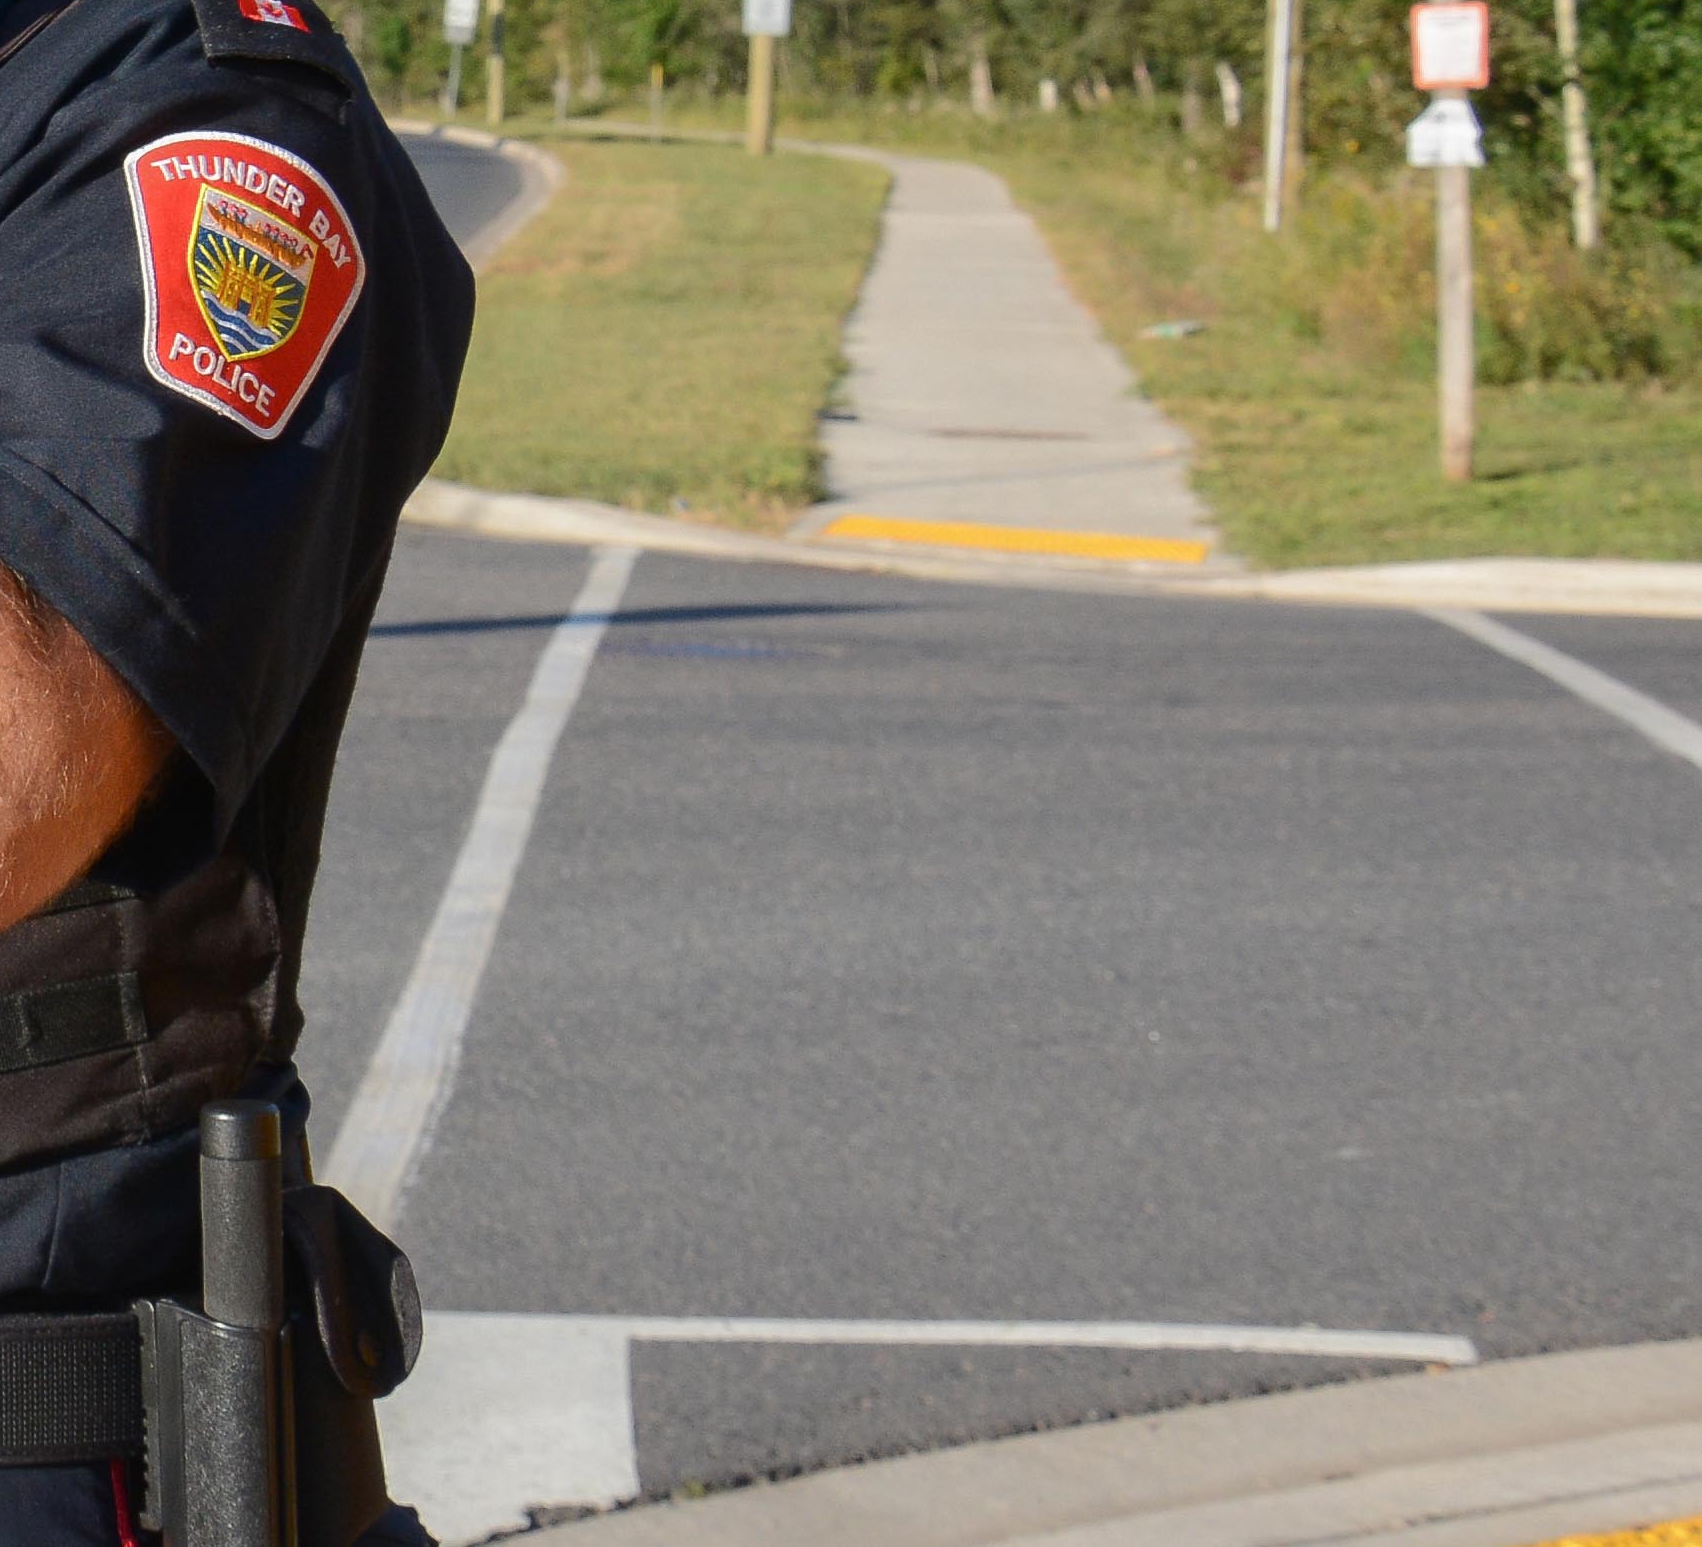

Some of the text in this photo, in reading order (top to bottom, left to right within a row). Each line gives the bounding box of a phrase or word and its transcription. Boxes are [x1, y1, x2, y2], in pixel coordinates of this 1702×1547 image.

[150, 155, 351, 269] THUNDER BAY
[168, 332, 276, 418] POLICE
